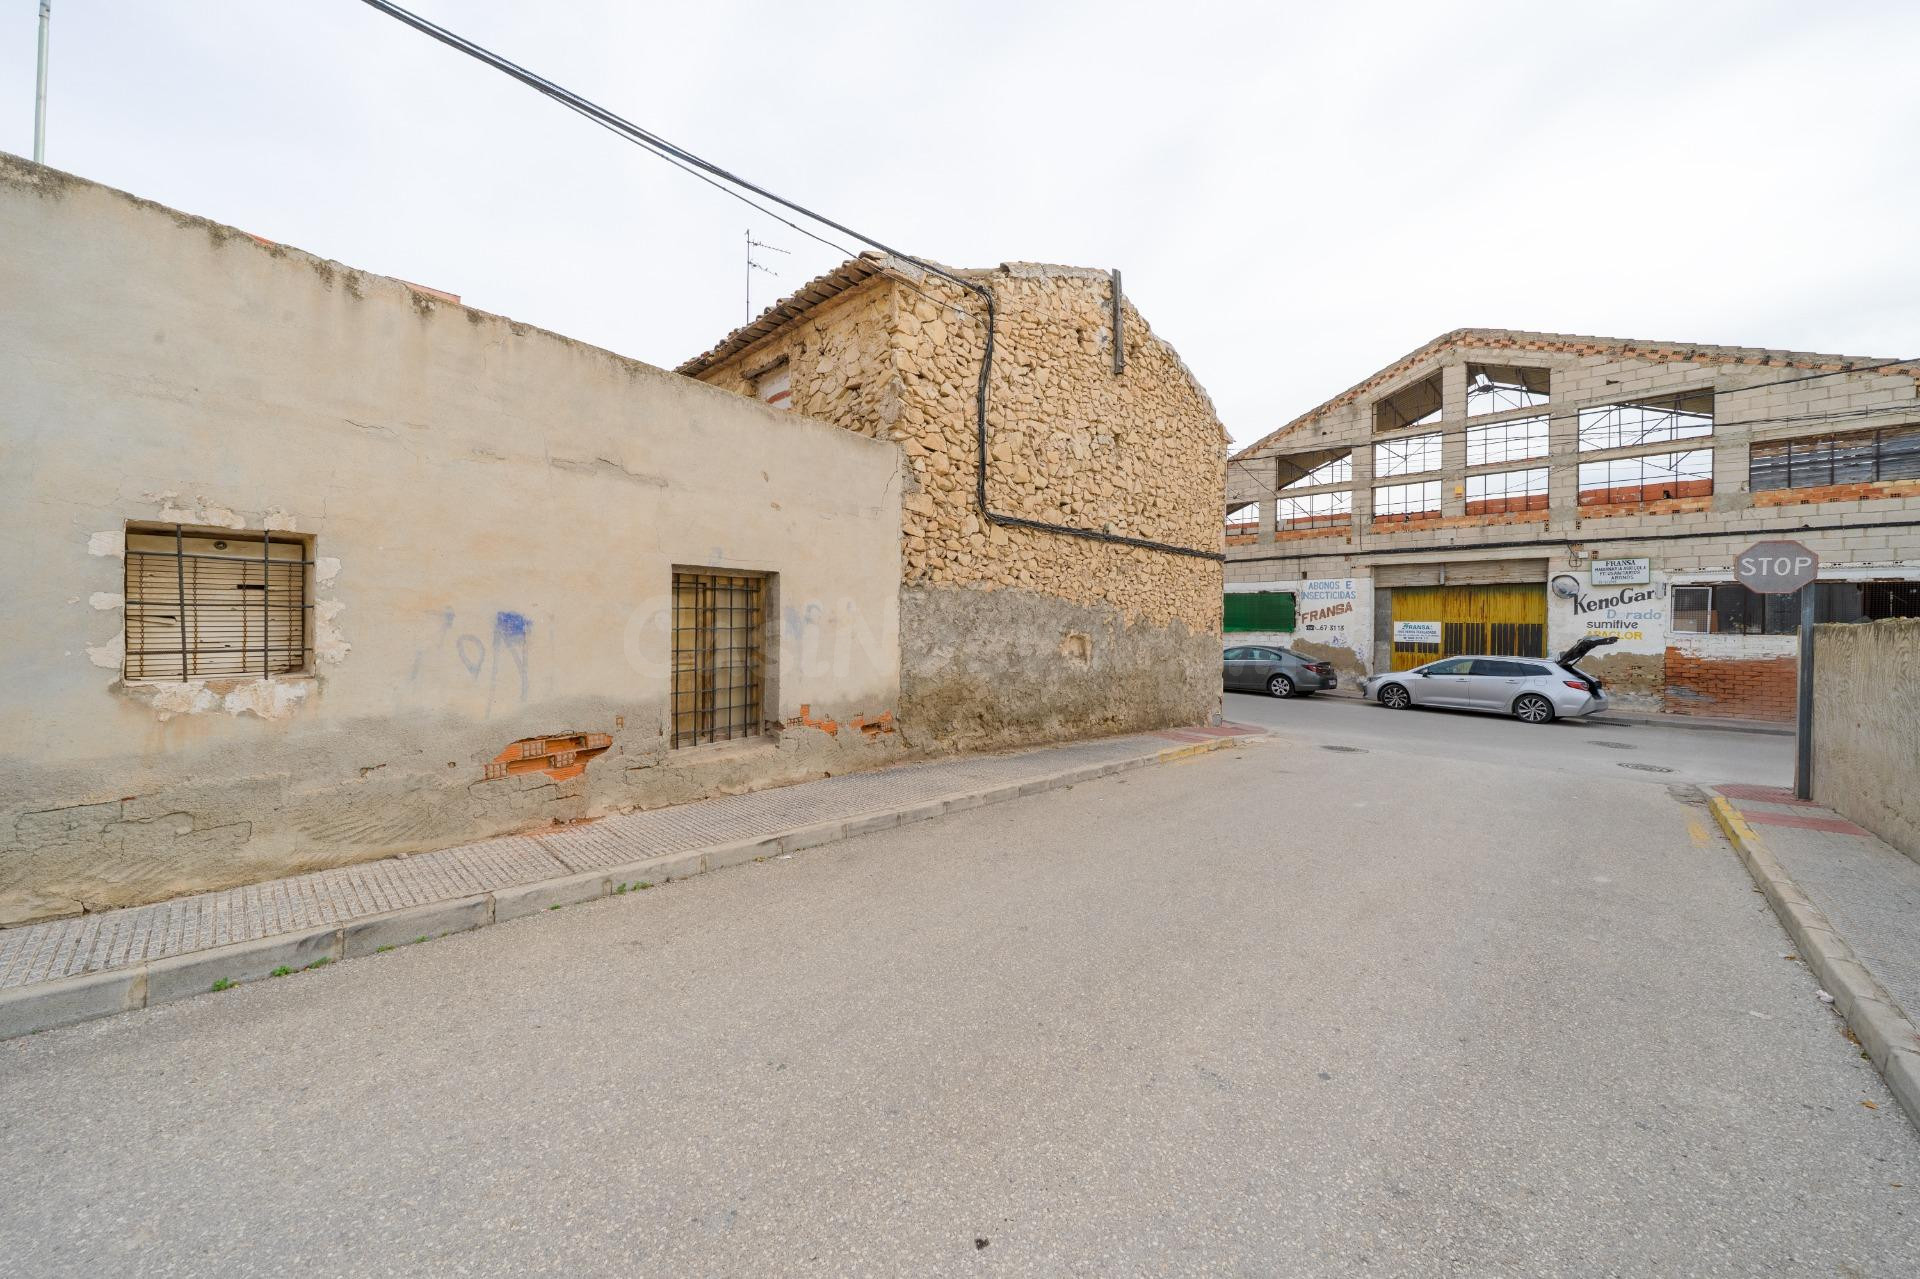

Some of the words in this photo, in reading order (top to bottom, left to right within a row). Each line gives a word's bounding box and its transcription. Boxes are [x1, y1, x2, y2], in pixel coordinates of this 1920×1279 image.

[1740, 557, 1812, 576] STOP
[1308, 581, 1340, 590] ABONOS
[1345, 581, 1353, 589] E
[1300, 591, 1357, 600] INSECTICIDAS
[1573, 587, 1666, 616] KenoGar
[1301, 601, 1353, 625] FRANSA
